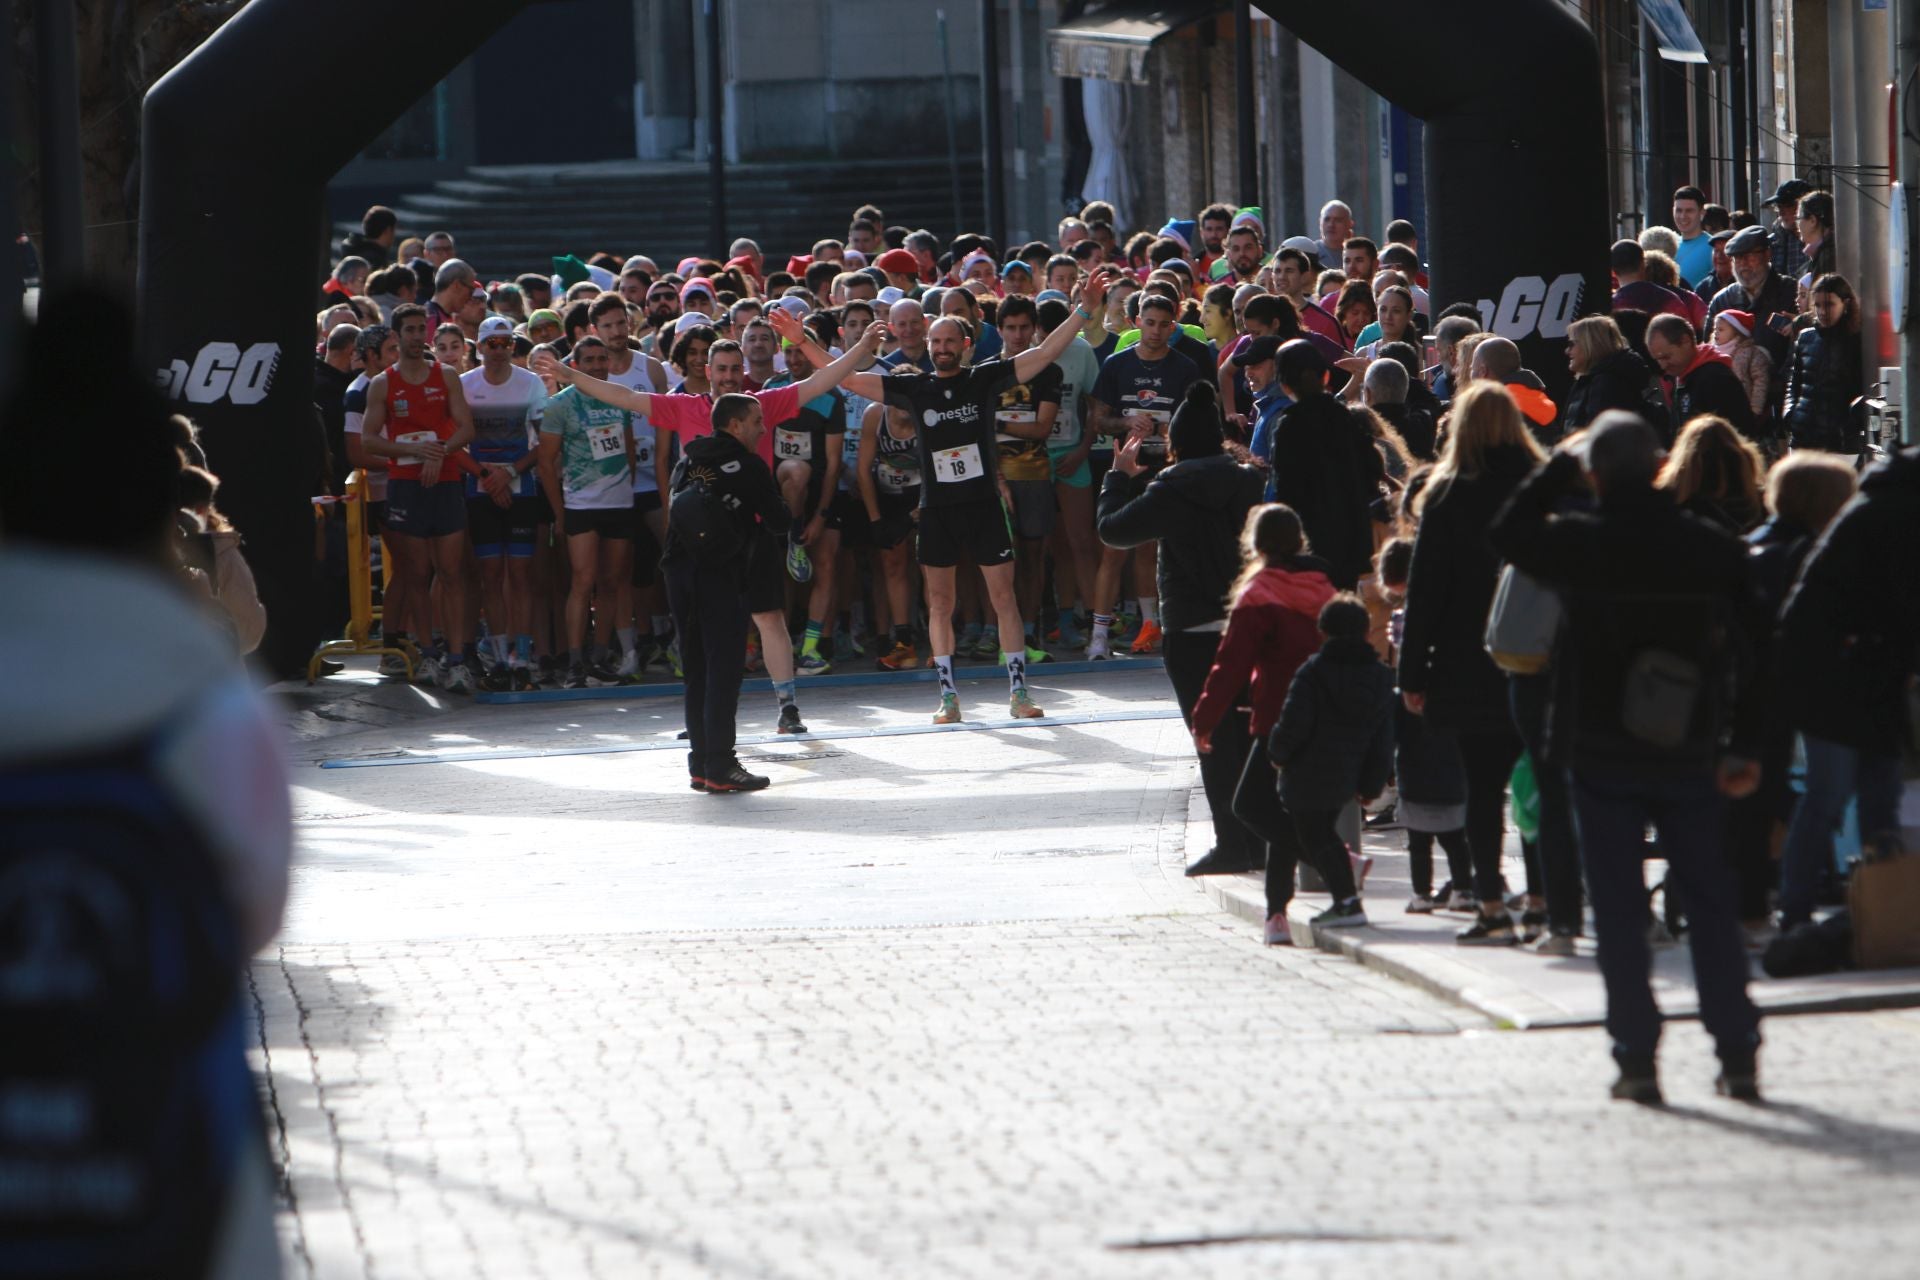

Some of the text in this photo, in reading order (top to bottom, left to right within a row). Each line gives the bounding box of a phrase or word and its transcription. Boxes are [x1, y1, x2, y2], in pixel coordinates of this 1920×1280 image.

[600, 436, 621, 454] 136
[780, 441, 801, 456] 182
[950, 460, 966, 477] 18
